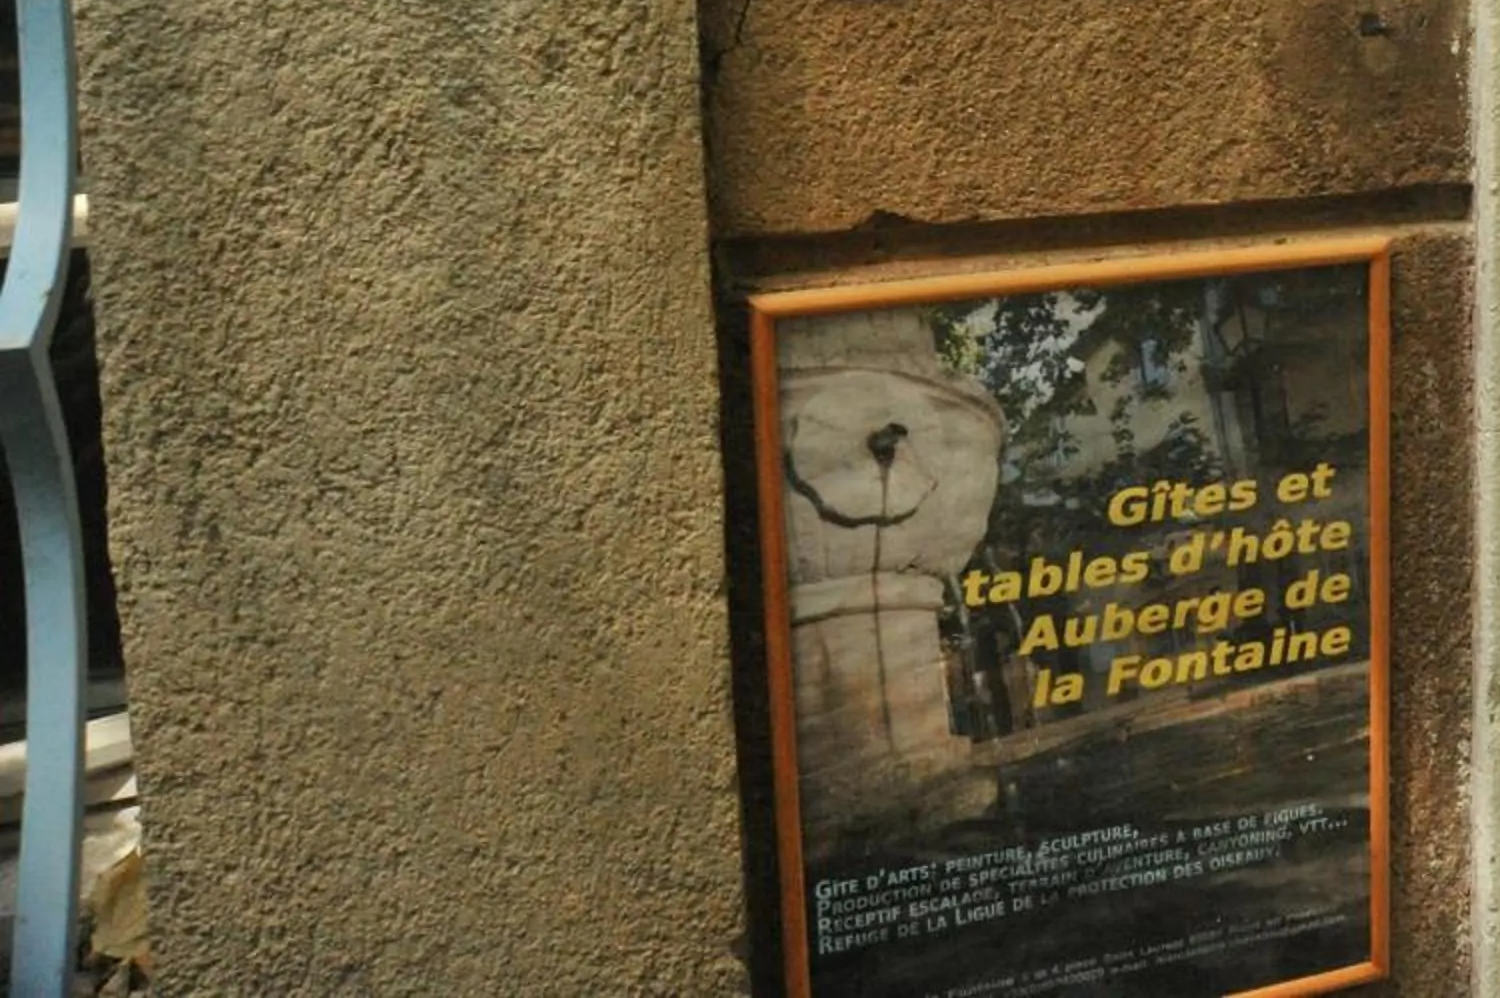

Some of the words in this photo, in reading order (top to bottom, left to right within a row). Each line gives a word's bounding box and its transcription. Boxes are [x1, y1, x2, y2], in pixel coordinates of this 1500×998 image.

[1108, 476, 1258, 526] Gîtes
[1277, 462, 1336, 502] et
[962, 550, 1150, 607] tables
[1169, 519, 1352, 575] d'hôte
[1018, 586, 1265, 655] Auberge
[1285, 569, 1351, 609] de
[1033, 668, 1083, 708] la
[1107, 625, 1352, 696] Fontaine
[816, 884, 932, 917] PRODUCTION
[940, 877, 961, 892] DE
[1193, 821, 1232, 840] BASE
[1237, 815, 1258, 830] DE
[818, 928, 889, 955] REFUGE
[897, 921, 920, 938] DE
[927, 914, 947, 933] LA
[954, 901, 1005, 926] LIGUE
[1012, 896, 1033, 912] DE
[1068, 868, 1168, 897] PROTECTION
[1172, 860, 1203, 879] DES
